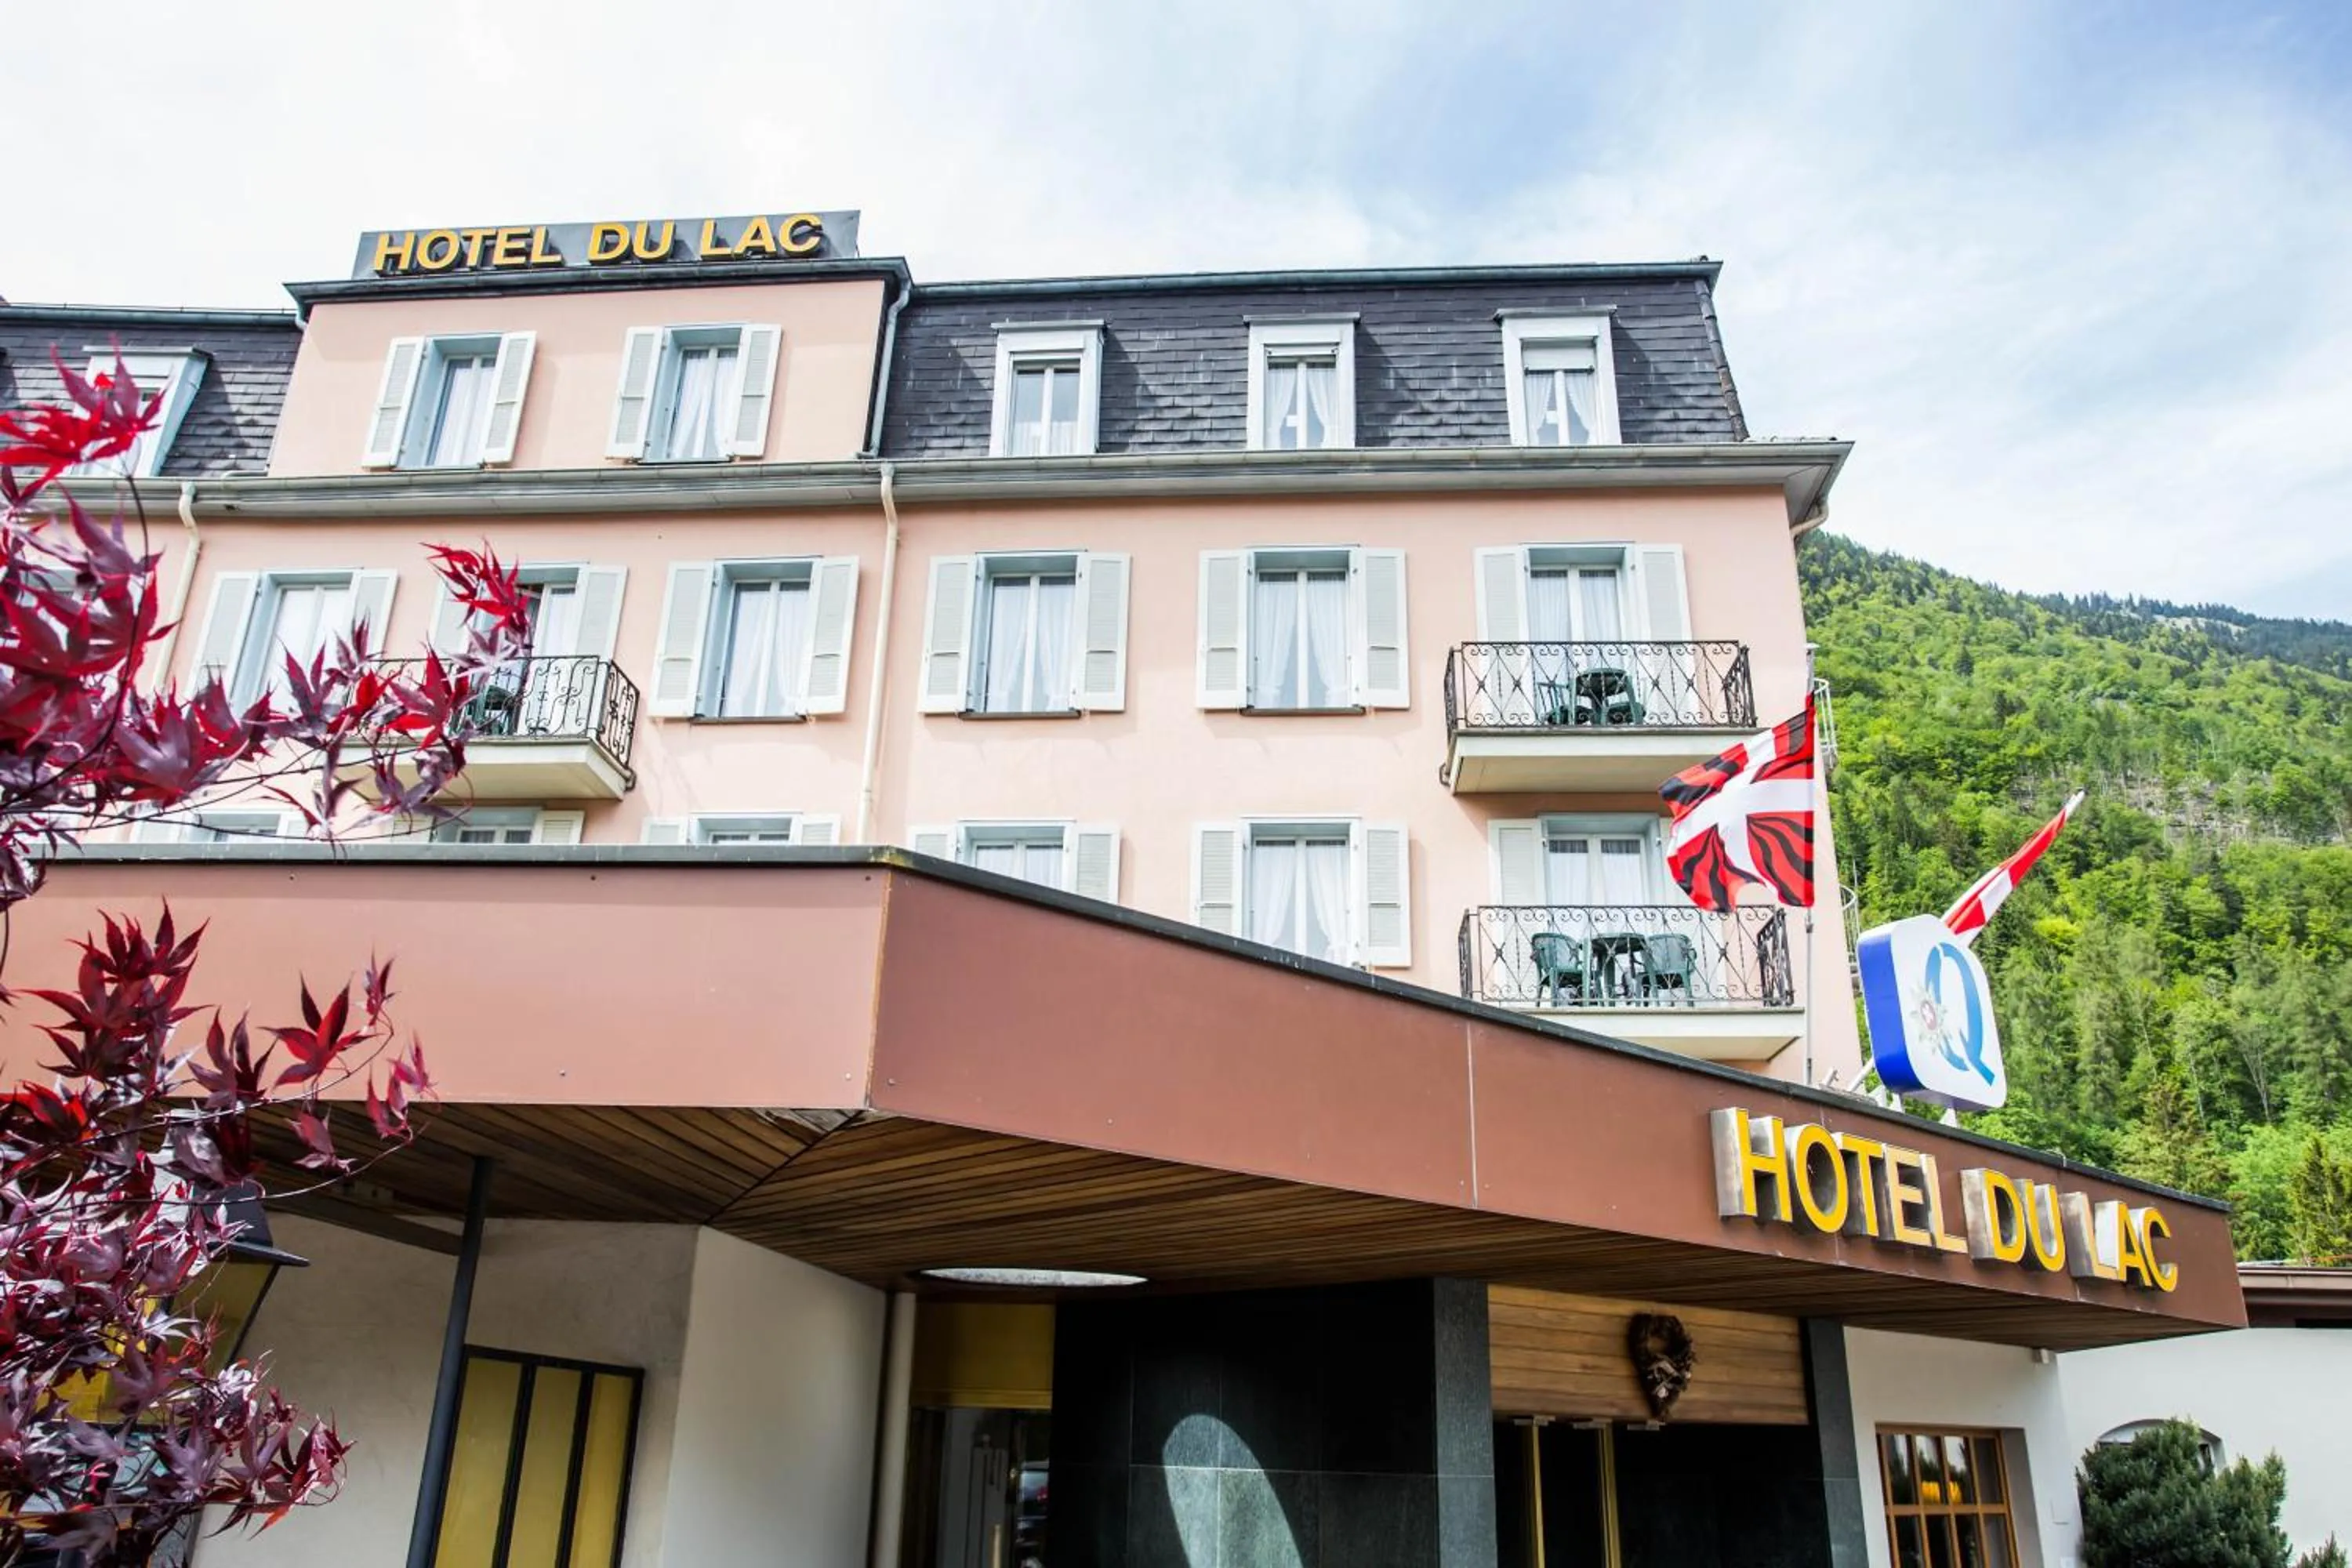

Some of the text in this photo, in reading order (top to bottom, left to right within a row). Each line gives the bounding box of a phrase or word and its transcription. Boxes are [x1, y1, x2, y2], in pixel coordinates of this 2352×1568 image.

[374, 213, 822, 271] HOTEL DU LAC
[1924, 942, 1995, 1087] Q
[1735, 1107, 2178, 1292] HOTEL DU LAC
